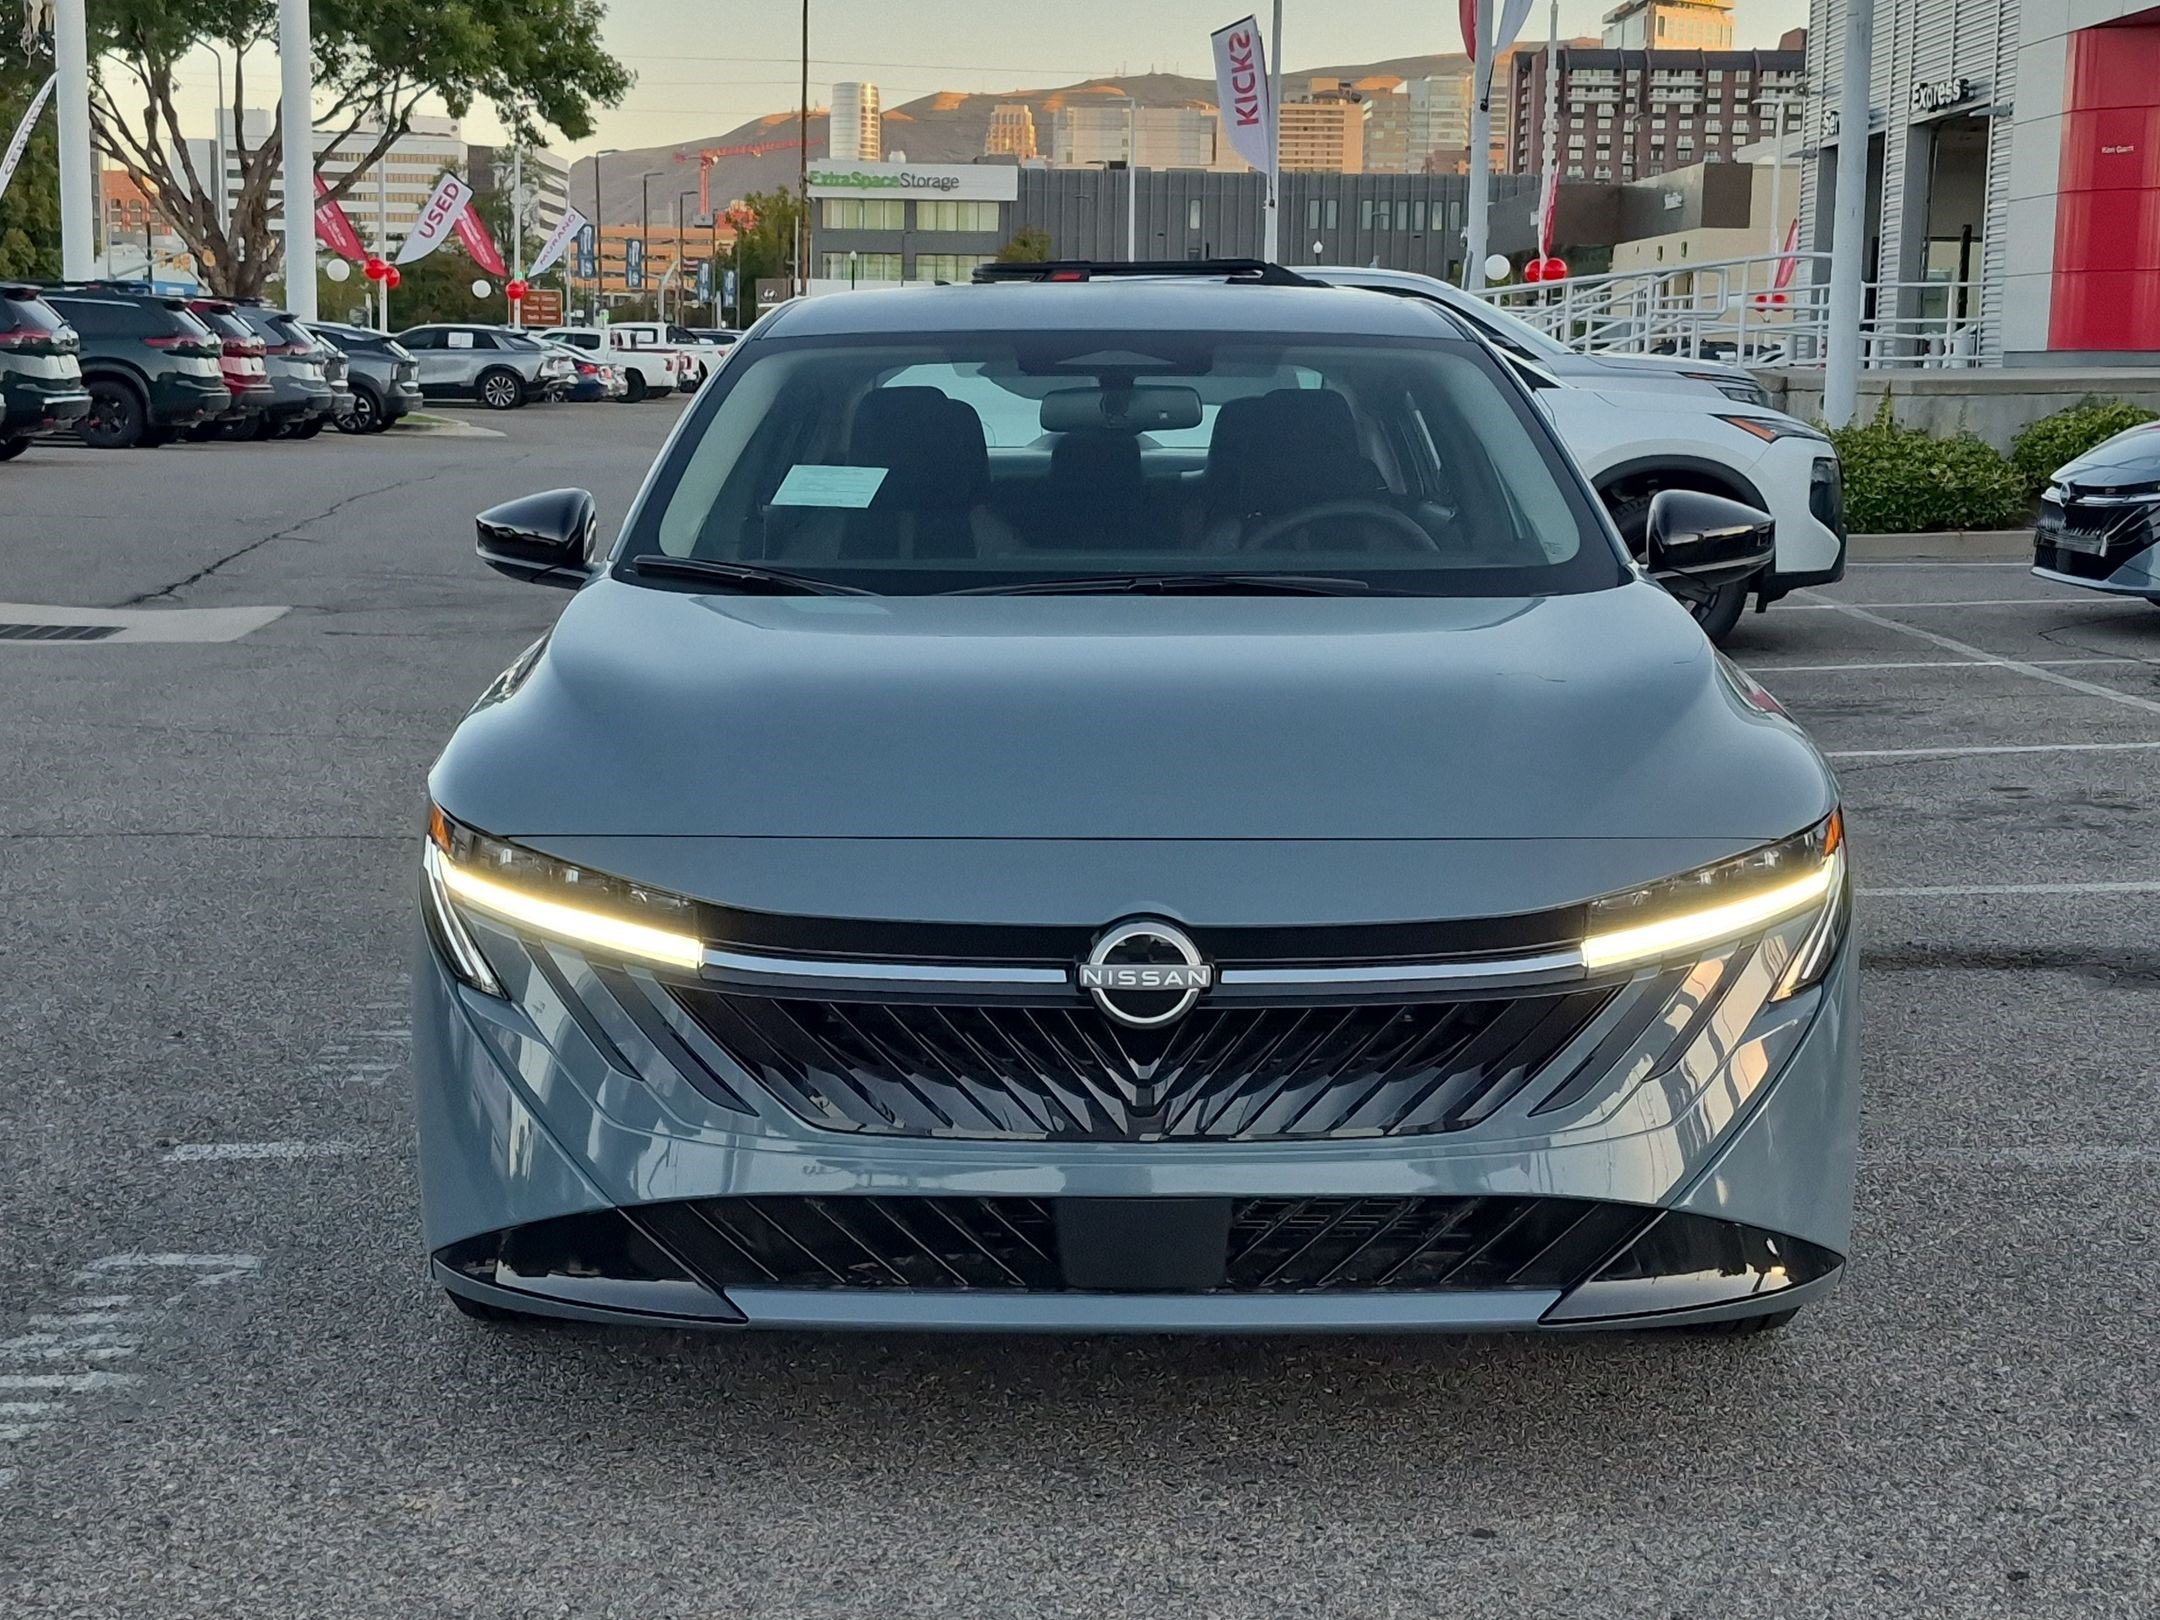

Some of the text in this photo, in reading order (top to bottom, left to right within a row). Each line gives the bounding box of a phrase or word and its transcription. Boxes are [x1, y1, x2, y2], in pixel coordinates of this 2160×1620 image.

[1911, 78, 1961, 112] Express
[418, 182, 460, 239] USED
[540, 213, 576, 265] MURANO
[1082, 968, 1207, 987] NISSAN
